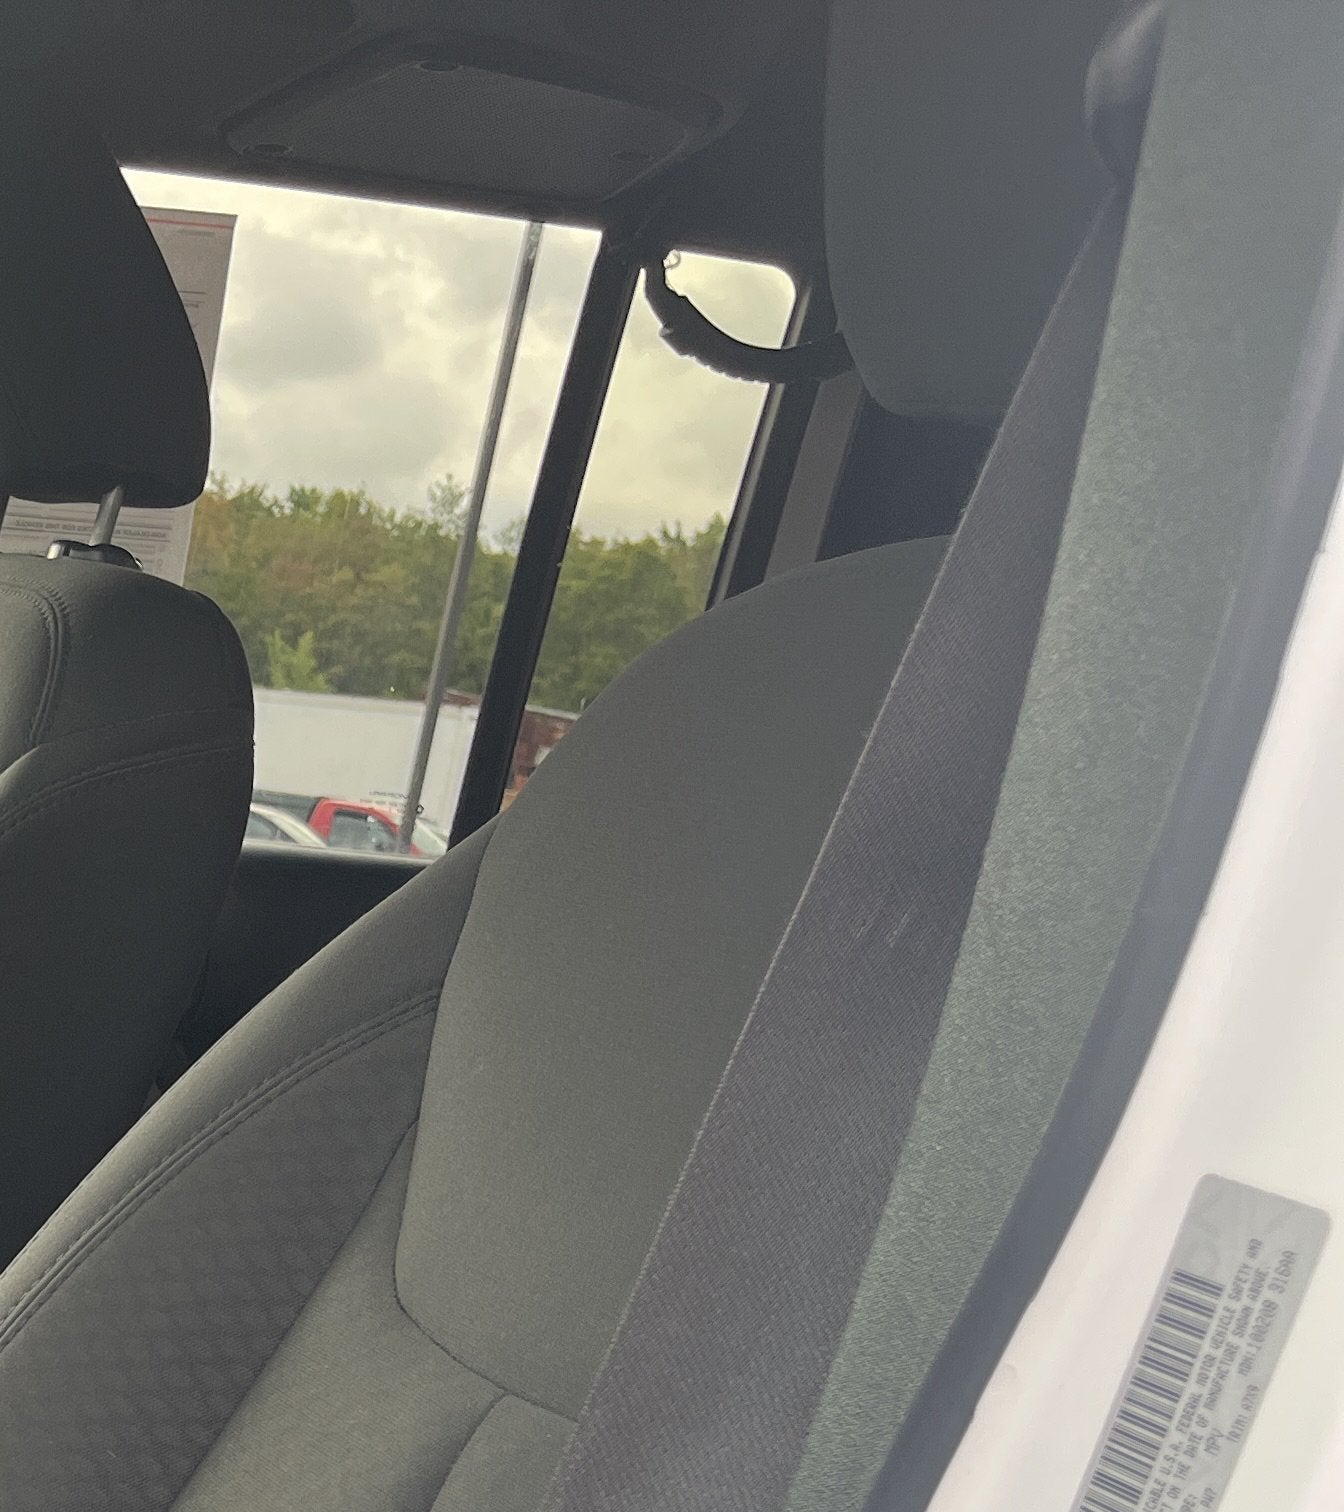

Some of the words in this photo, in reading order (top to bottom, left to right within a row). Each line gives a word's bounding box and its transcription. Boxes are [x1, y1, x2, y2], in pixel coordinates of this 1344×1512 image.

[1230, 1303, 1255, 1339] SHOWN
[1157, 1435, 1183, 1476] U.S.A.
[1174, 1389, 1202, 1434] FEDERAL
[1193, 1352, 1217, 1387] MOTOR
[1207, 1304, 1237, 1351] VEHICLE
[1226, 1261, 1254, 1302] SAFETY
[1244, 1237, 1264, 1259] AND
[1200, 1340, 1240, 1412] MANUFACTURE
[1193, 1413, 1210, 1429] OF
[1181, 1429, 1203, 1459] DATE
[1202, 1426, 1227, 1457] MPV
[1172, 1460, 1191, 1481] THE
[1164, 1483, 1181, 1500] ON
